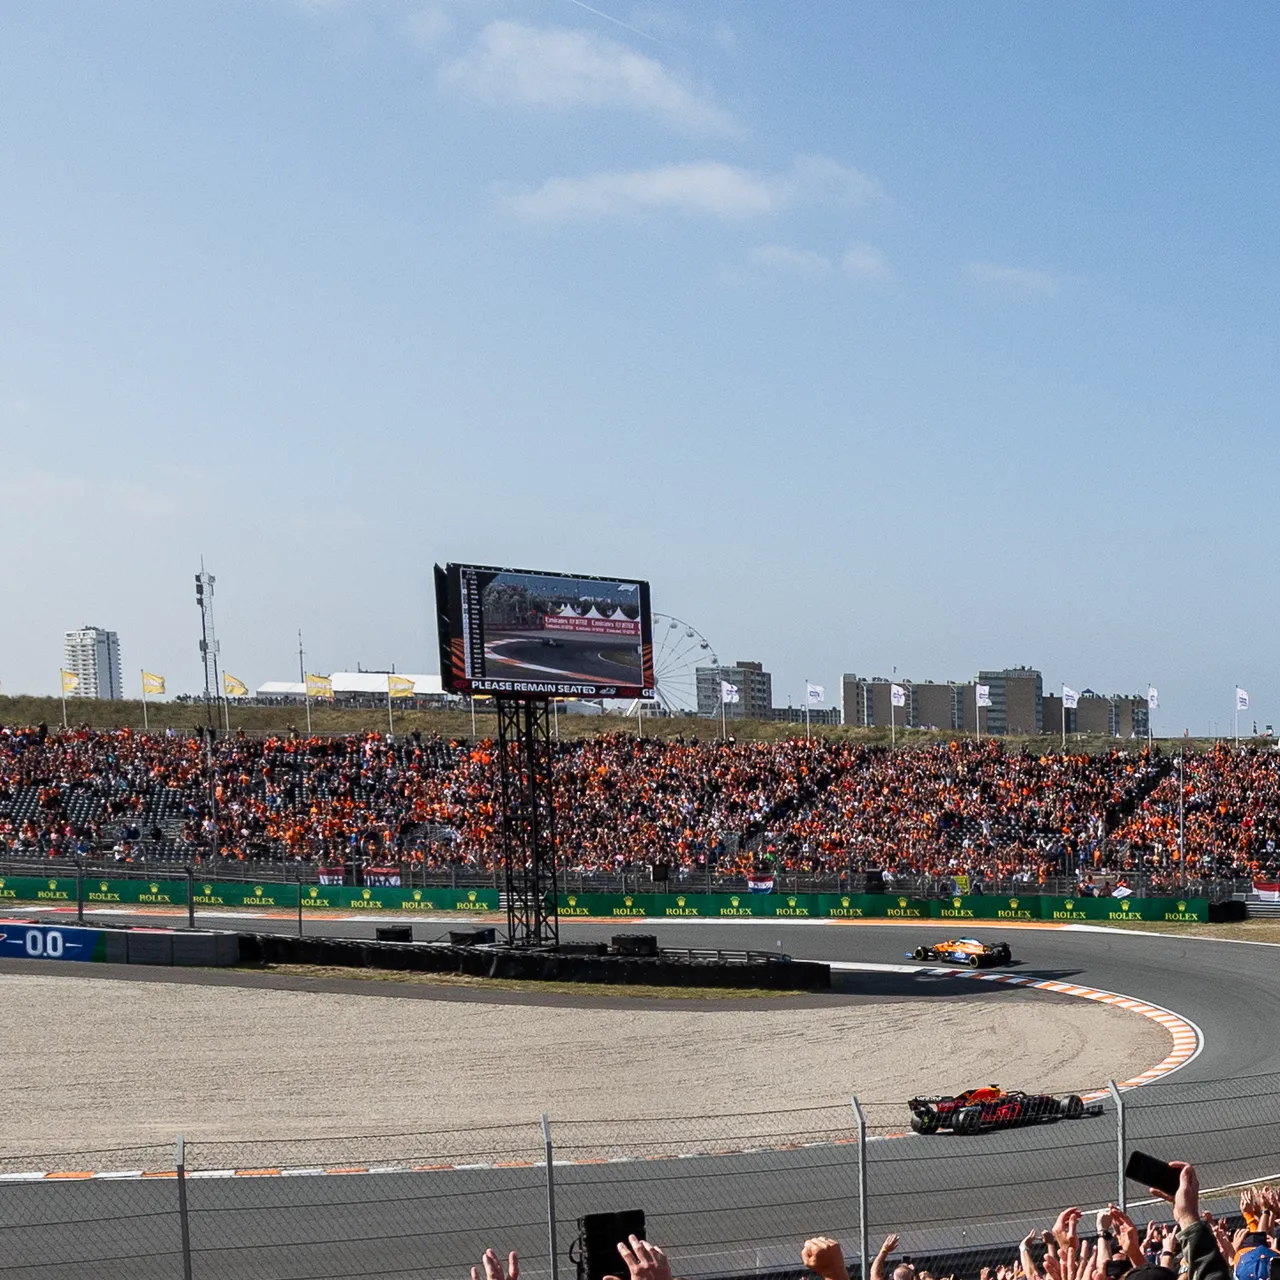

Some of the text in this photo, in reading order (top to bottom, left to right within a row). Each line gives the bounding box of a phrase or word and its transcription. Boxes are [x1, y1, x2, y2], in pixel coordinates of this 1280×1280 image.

[471, 681, 512, 691] PLEASE
[514, 682, 556, 693] REMAIN
[557, 684, 596, 694] SEATED
[0, 889, 16, 898] LEX
[38, 891, 68, 899] ROLEX
[89, 892, 120, 901] ROLEX
[139, 894, 171, 903] ROLEX
[193, 895, 223, 904] ROLEX
[243, 897, 274, 905] ROLEX
[351, 900, 382, 909] ROLEX
[402, 901, 433, 909] ROLEX
[456, 902, 488, 910] ROLEX
[557, 907, 589, 915] ROLEX
[613, 908, 645, 916] ROLEX
[666, 908, 698, 916] ROLEX
[720, 908, 752, 916] ROLEX
[776, 908, 808, 916] ROLEX
[830, 908, 863, 916] ROLEX
[887, 908, 920, 917] ROLEX
[941, 909, 974, 917] ROLEX
[998, 910, 1031, 918] ROLEX
[1053, 911, 1086, 920] ROLEX
[1109, 912, 1142, 921] ROLEX
[1165, 913, 1198, 921] ROLEX
[26, 930, 63, 957] 0.0
